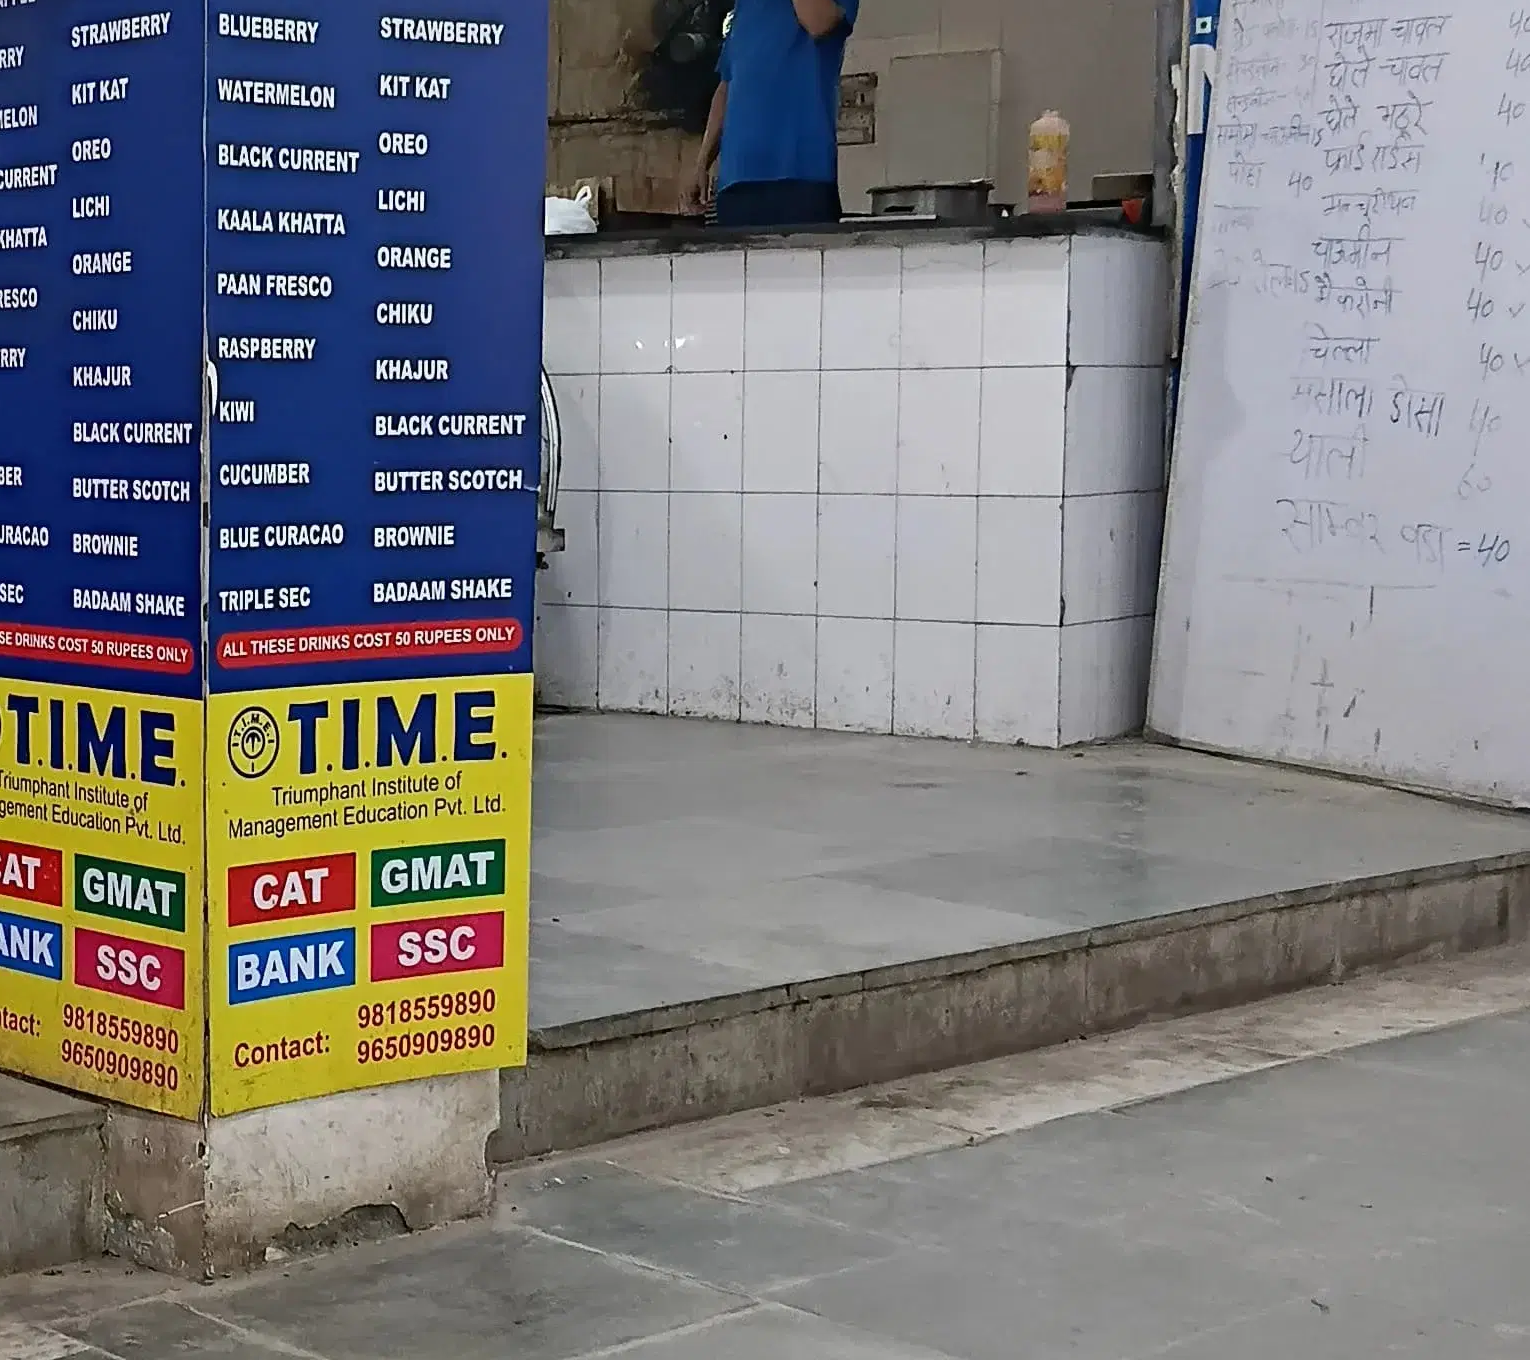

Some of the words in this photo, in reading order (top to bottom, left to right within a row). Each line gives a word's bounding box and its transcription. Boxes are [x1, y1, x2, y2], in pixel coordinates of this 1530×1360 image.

[72, 12, 170, 47] STRAWBERRY
[219, 14, 318, 43] BLUEBERRY
[380, 18, 504, 45] STRAWBERRY
[72, 81, 96, 105] KIT
[99, 78, 128, 101] KAT
[218, 78, 335, 108] WATERMELON
[380, 75, 410, 97] KIT
[415, 77, 450, 99] KAT
[72, 138, 111, 160] OREO
[379, 132, 428, 155] OREO
[219, 144, 273, 168] BLACK
[278, 148, 359, 173] CURRENT
[1288, 172, 1312, 197] 40
[73, 196, 109, 218] LICHI
[379, 190, 425, 212] LICHI
[218, 209, 273, 232] KAALA
[279, 212, 345, 235] KHATTA
[73, 252, 131, 274] ORANGE
[378, 247, 451, 268] ORANGE
[1475, 242, 1503, 283] 40
[218, 273, 260, 295] PAAN
[267, 275, 332, 297] FRESCO
[377, 304, 433, 323] CHIKU
[1467, 288, 1494, 323] 40
[73, 309, 117, 330] CHIKU
[219, 337, 315, 359] RASPBERRY
[73, 366, 131, 386] KHAJUR
[376, 360, 448, 380] KHAJUR
[220, 401, 254, 422] KIWI
[74, 422, 120, 443] BLACK
[124, 423, 192, 444] CURRENT
[376, 416, 433, 436] BLACK
[438, 415, 526, 435] CURRENT
[220, 464, 310, 485] CUCUMBER
[374, 471, 443, 492] BUTTER
[449, 470, 522, 490] SCOTCH
[73, 479, 128, 499] BUTTER
[133, 480, 190, 502] SCOTCH
[73, 534, 138, 556] BROWNIE
[220, 526, 259, 548] BLUE
[265, 524, 343, 547] CURACAO
[374, 526, 454, 547] BROWNIE
[1478, 533, 1510, 567] 40
[0, 583, 23, 603] SEC
[74, 589, 131, 612] BADAAM
[136, 595, 185, 616] SHAKE
[220, 589, 274, 611] TRIPLE
[279, 587, 310, 609] SEC
[374, 581, 445, 603] BADAAM
[451, 579, 512, 600] SHAKE
[223, 642, 247, 657] ALL
[251, 638, 295, 654] THESE
[298, 635, 350, 651] DRINKS
[354, 633, 391, 648] COST
[396, 632, 411, 645] 50
[415, 629, 471, 644] RUPEES
[475, 626, 515, 641] ONLY
[8, 693, 186, 787] T.I.M.E.
[288, 691, 507, 774] T.I.M.E.
[272, 780, 366, 807] Triumphant
[373, 773, 439, 797] Institute
[445, 771, 462, 790] of
[229, 808, 338, 840] Management
[344, 800, 428, 826] Education
[435, 798, 467, 817] Pvt.
[474, 794, 505, 814] Ltd.
[381, 851, 494, 894] GMAT
[82, 868, 176, 917] GMAT
[253, 868, 329, 910] CAT
[398, 926, 475, 967] SSC
[97, 945, 161, 990] SSC
[237, 941, 344, 990] BANK
[358, 989, 496, 1028] 9818559890
[63, 1004, 178, 1054] 9818559890
[234, 1031, 330, 1067] Contact:
[358, 1024, 495, 1064] 9650909890
[62, 1039, 178, 1090] 9650909890
